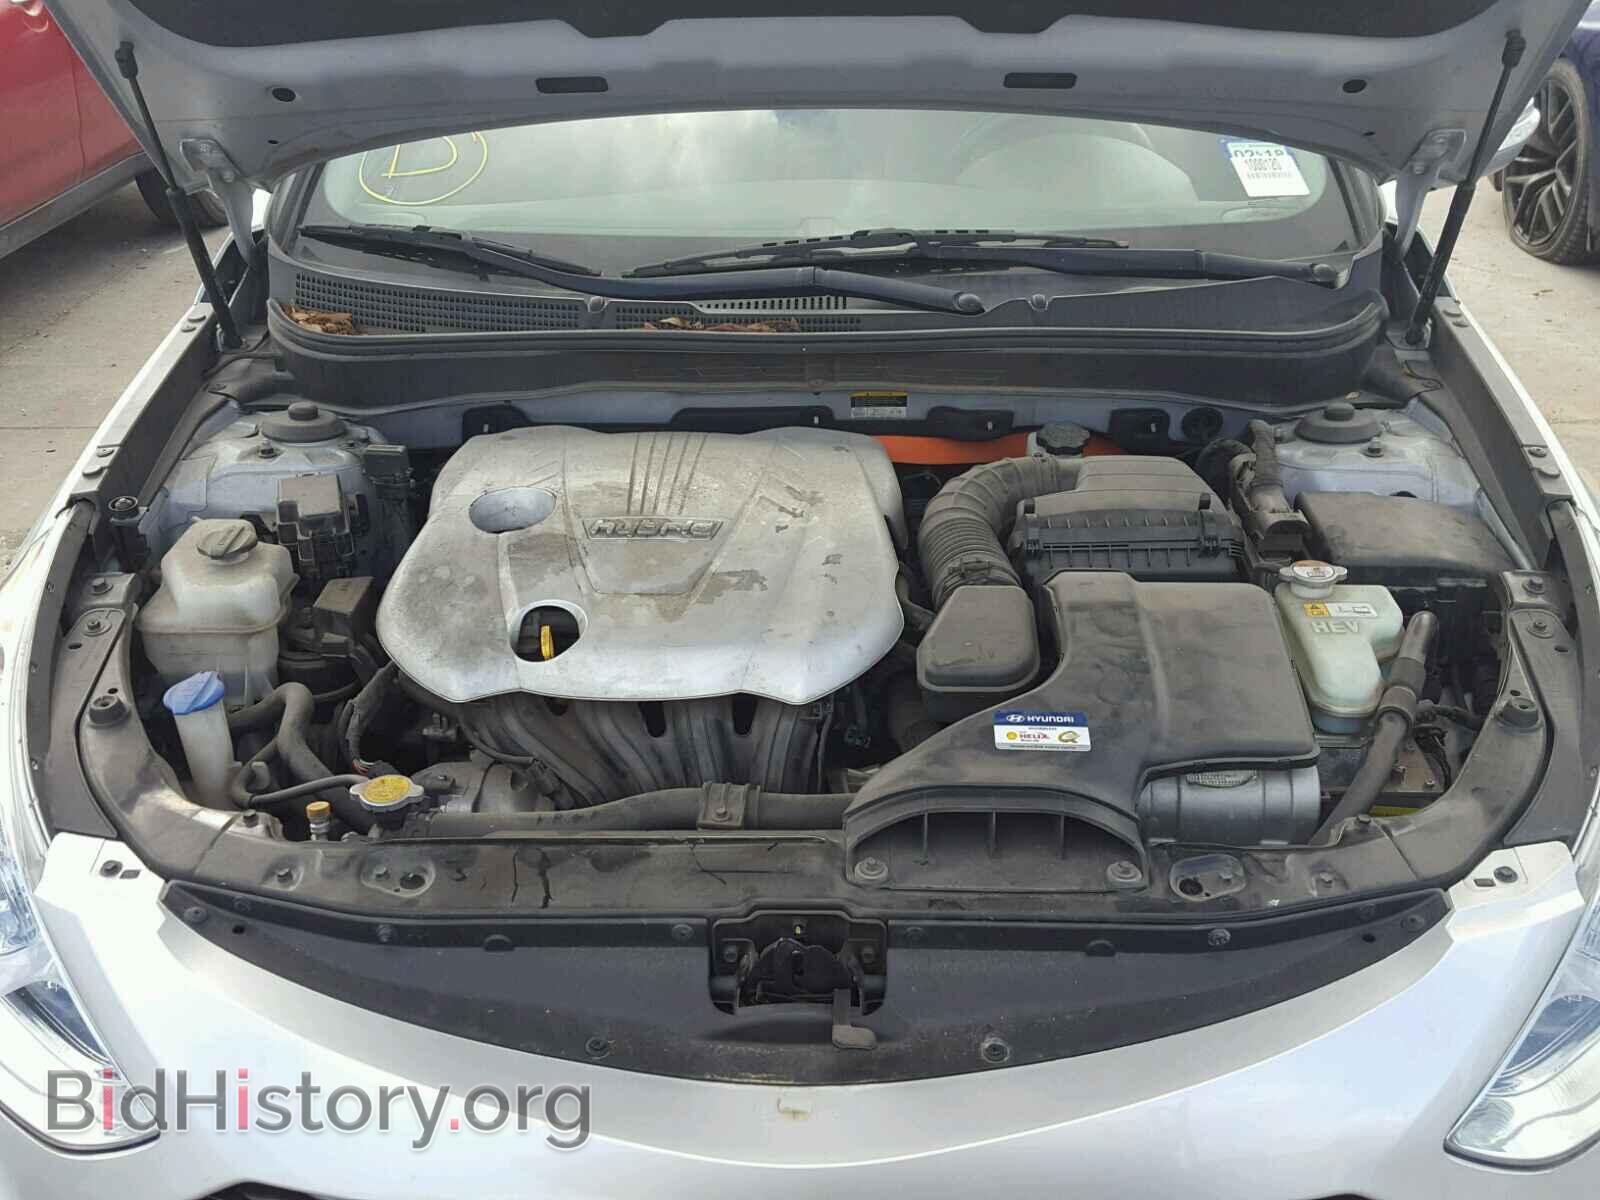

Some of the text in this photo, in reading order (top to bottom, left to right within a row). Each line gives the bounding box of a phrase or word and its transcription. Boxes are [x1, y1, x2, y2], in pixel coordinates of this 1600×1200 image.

[1311, 621, 1360, 633] HEV
[1027, 715, 1074, 723] HYUNDAI
[1019, 732, 1050, 740] HELIX
